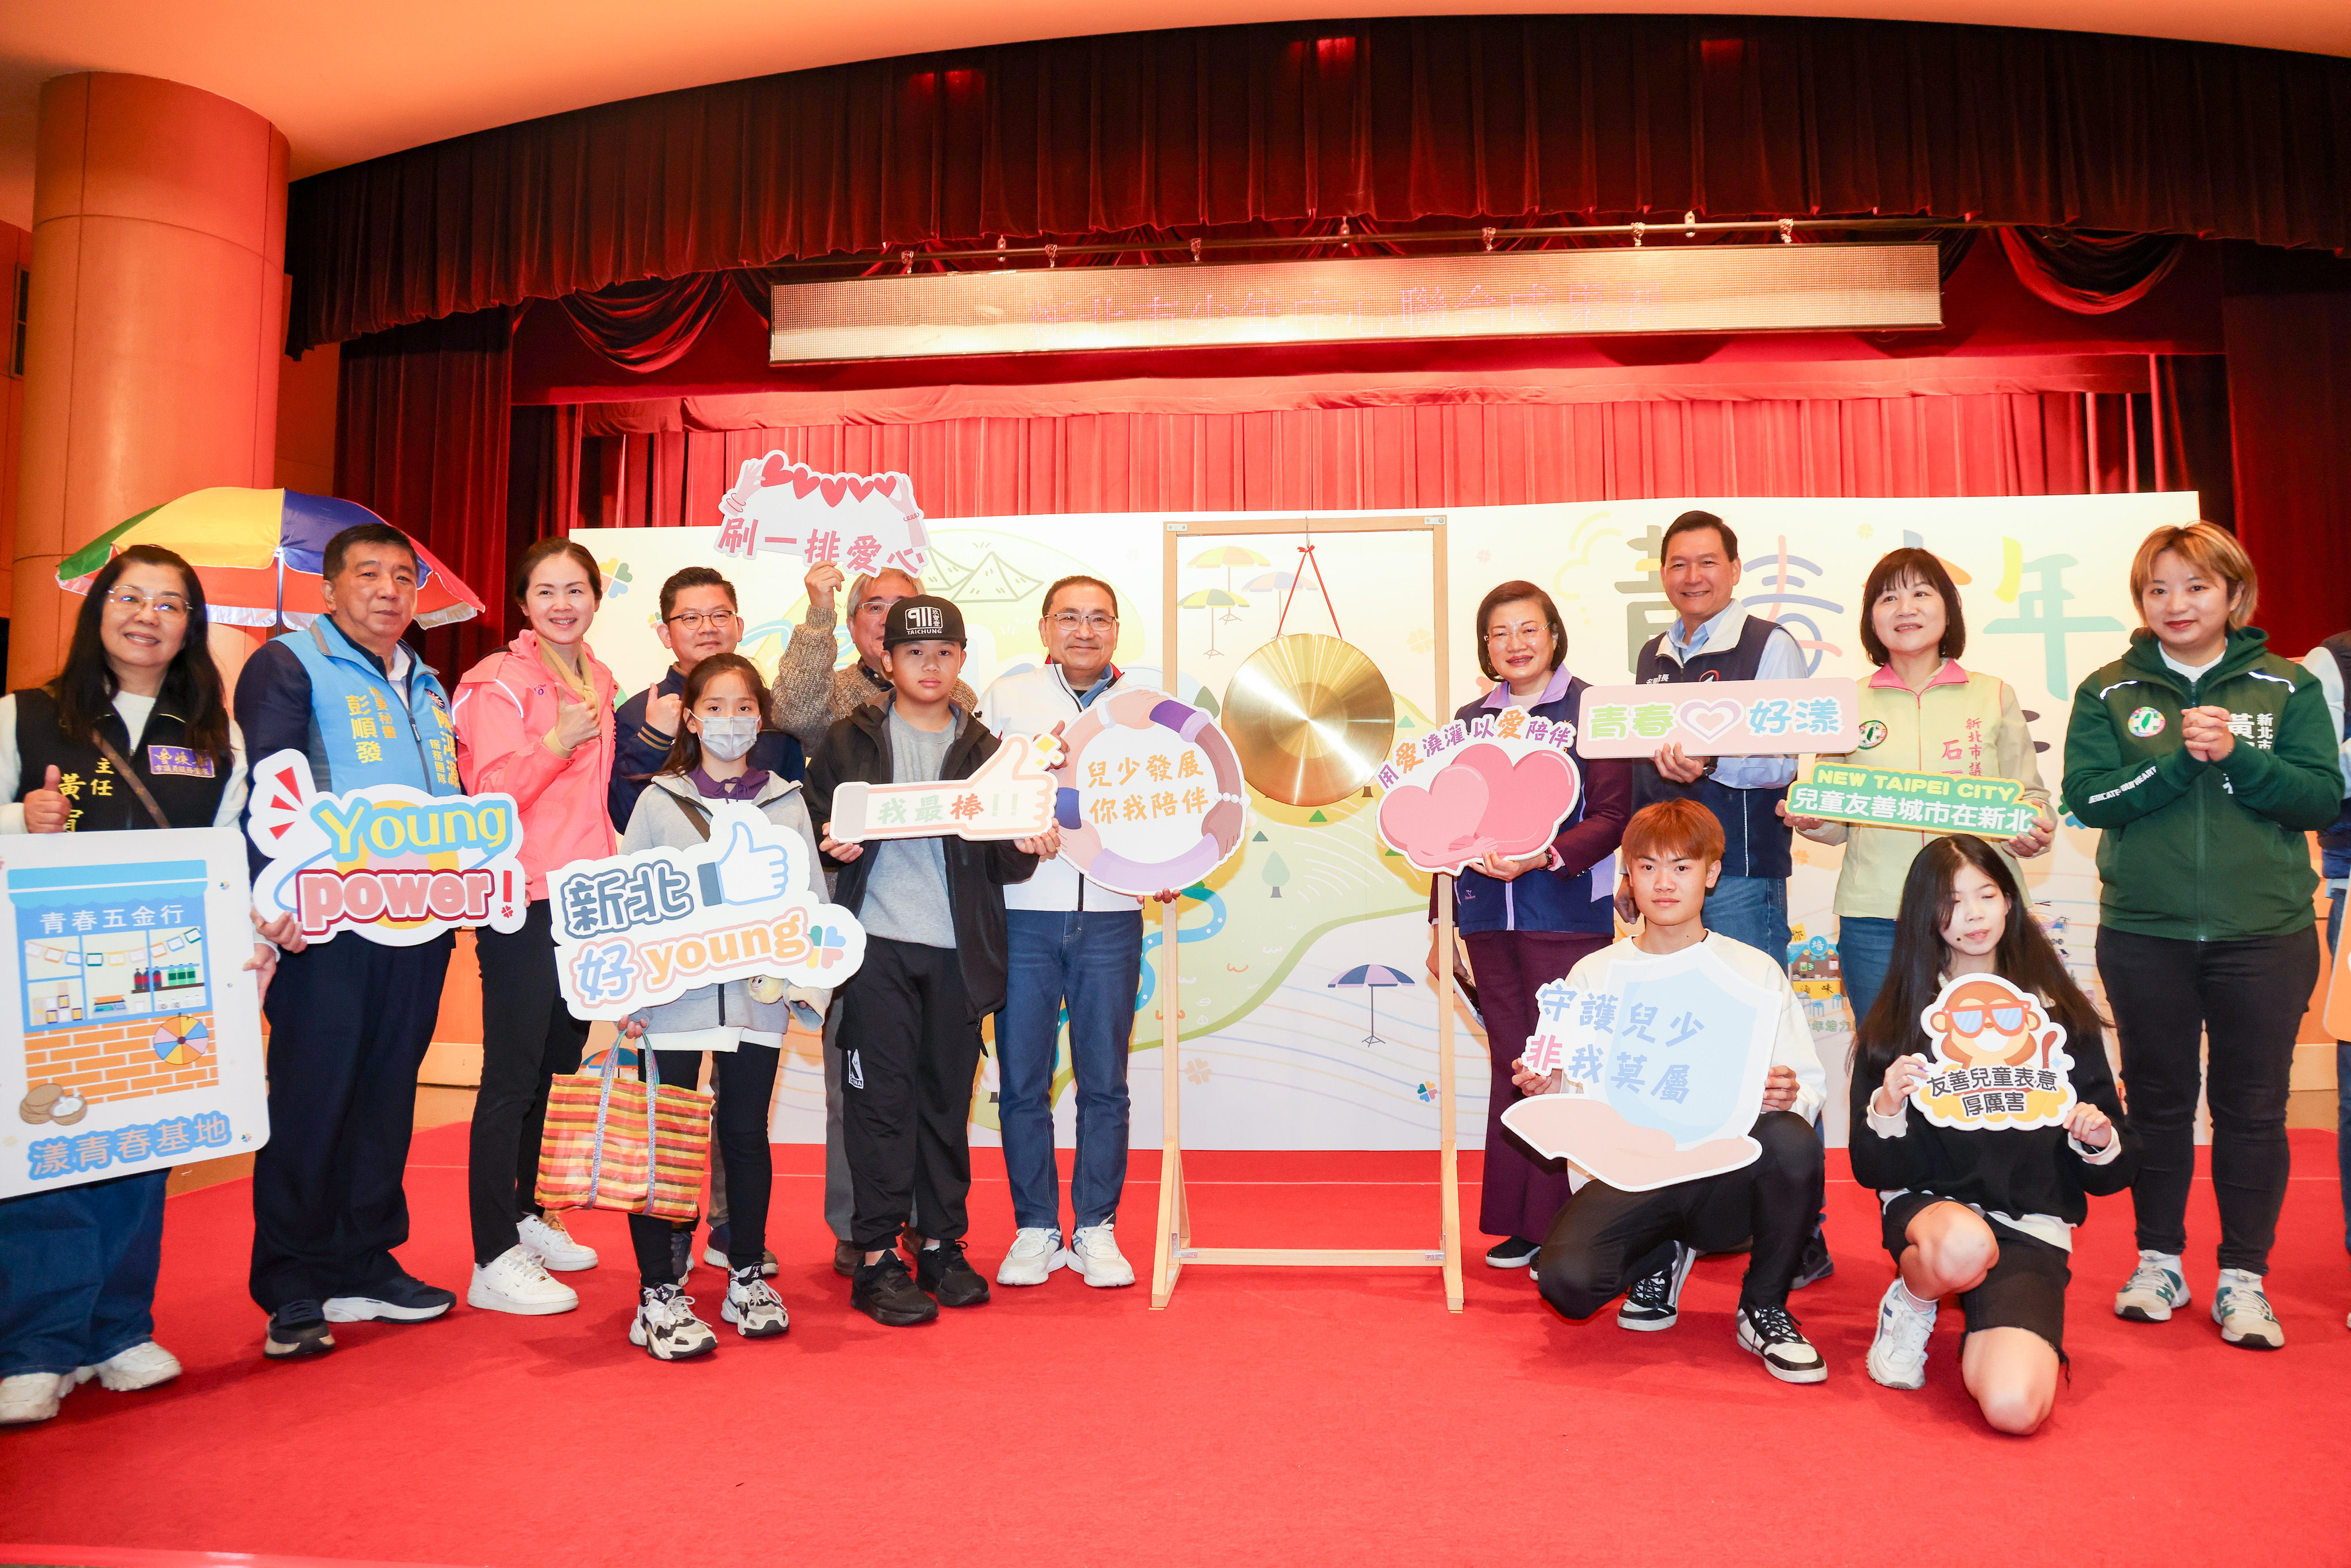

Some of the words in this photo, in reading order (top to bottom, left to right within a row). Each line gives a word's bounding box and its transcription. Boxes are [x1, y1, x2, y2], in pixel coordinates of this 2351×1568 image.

[718, 518, 924, 575] 刷一排愛心
[346, 695, 383, 763] 彭順發
[1592, 704, 1674, 739] 青春
[1749, 698, 1840, 734] 好漾
[2225, 713, 2256, 747] 黃
[90, 757, 114, 796] 主任
[429, 739, 447, 784] 服務團隊
[1088, 750, 1204, 788] 兒少發展
[1089, 786, 1209, 825] 你我陪伴
[1817, 769, 1867, 787] NEW
[1873, 775, 1950, 796] TAIPEI
[1958, 783, 2015, 802] CITY
[319, 805, 507, 855] Young
[1792, 787, 2034, 834] 兒童友善城市在新北
[41, 904, 184, 935] 青春五金行
[568, 865, 686, 931] 新北
[1540, 984, 1705, 1047] 守護兒少
[1526, 1034, 1691, 1105] 非我莫屬
[1926, 1066, 2058, 1098] 友善兒童表意
[1962, 1092, 2024, 1117] 厚厲害
[33, 1113, 228, 1177] 漾青春基地
